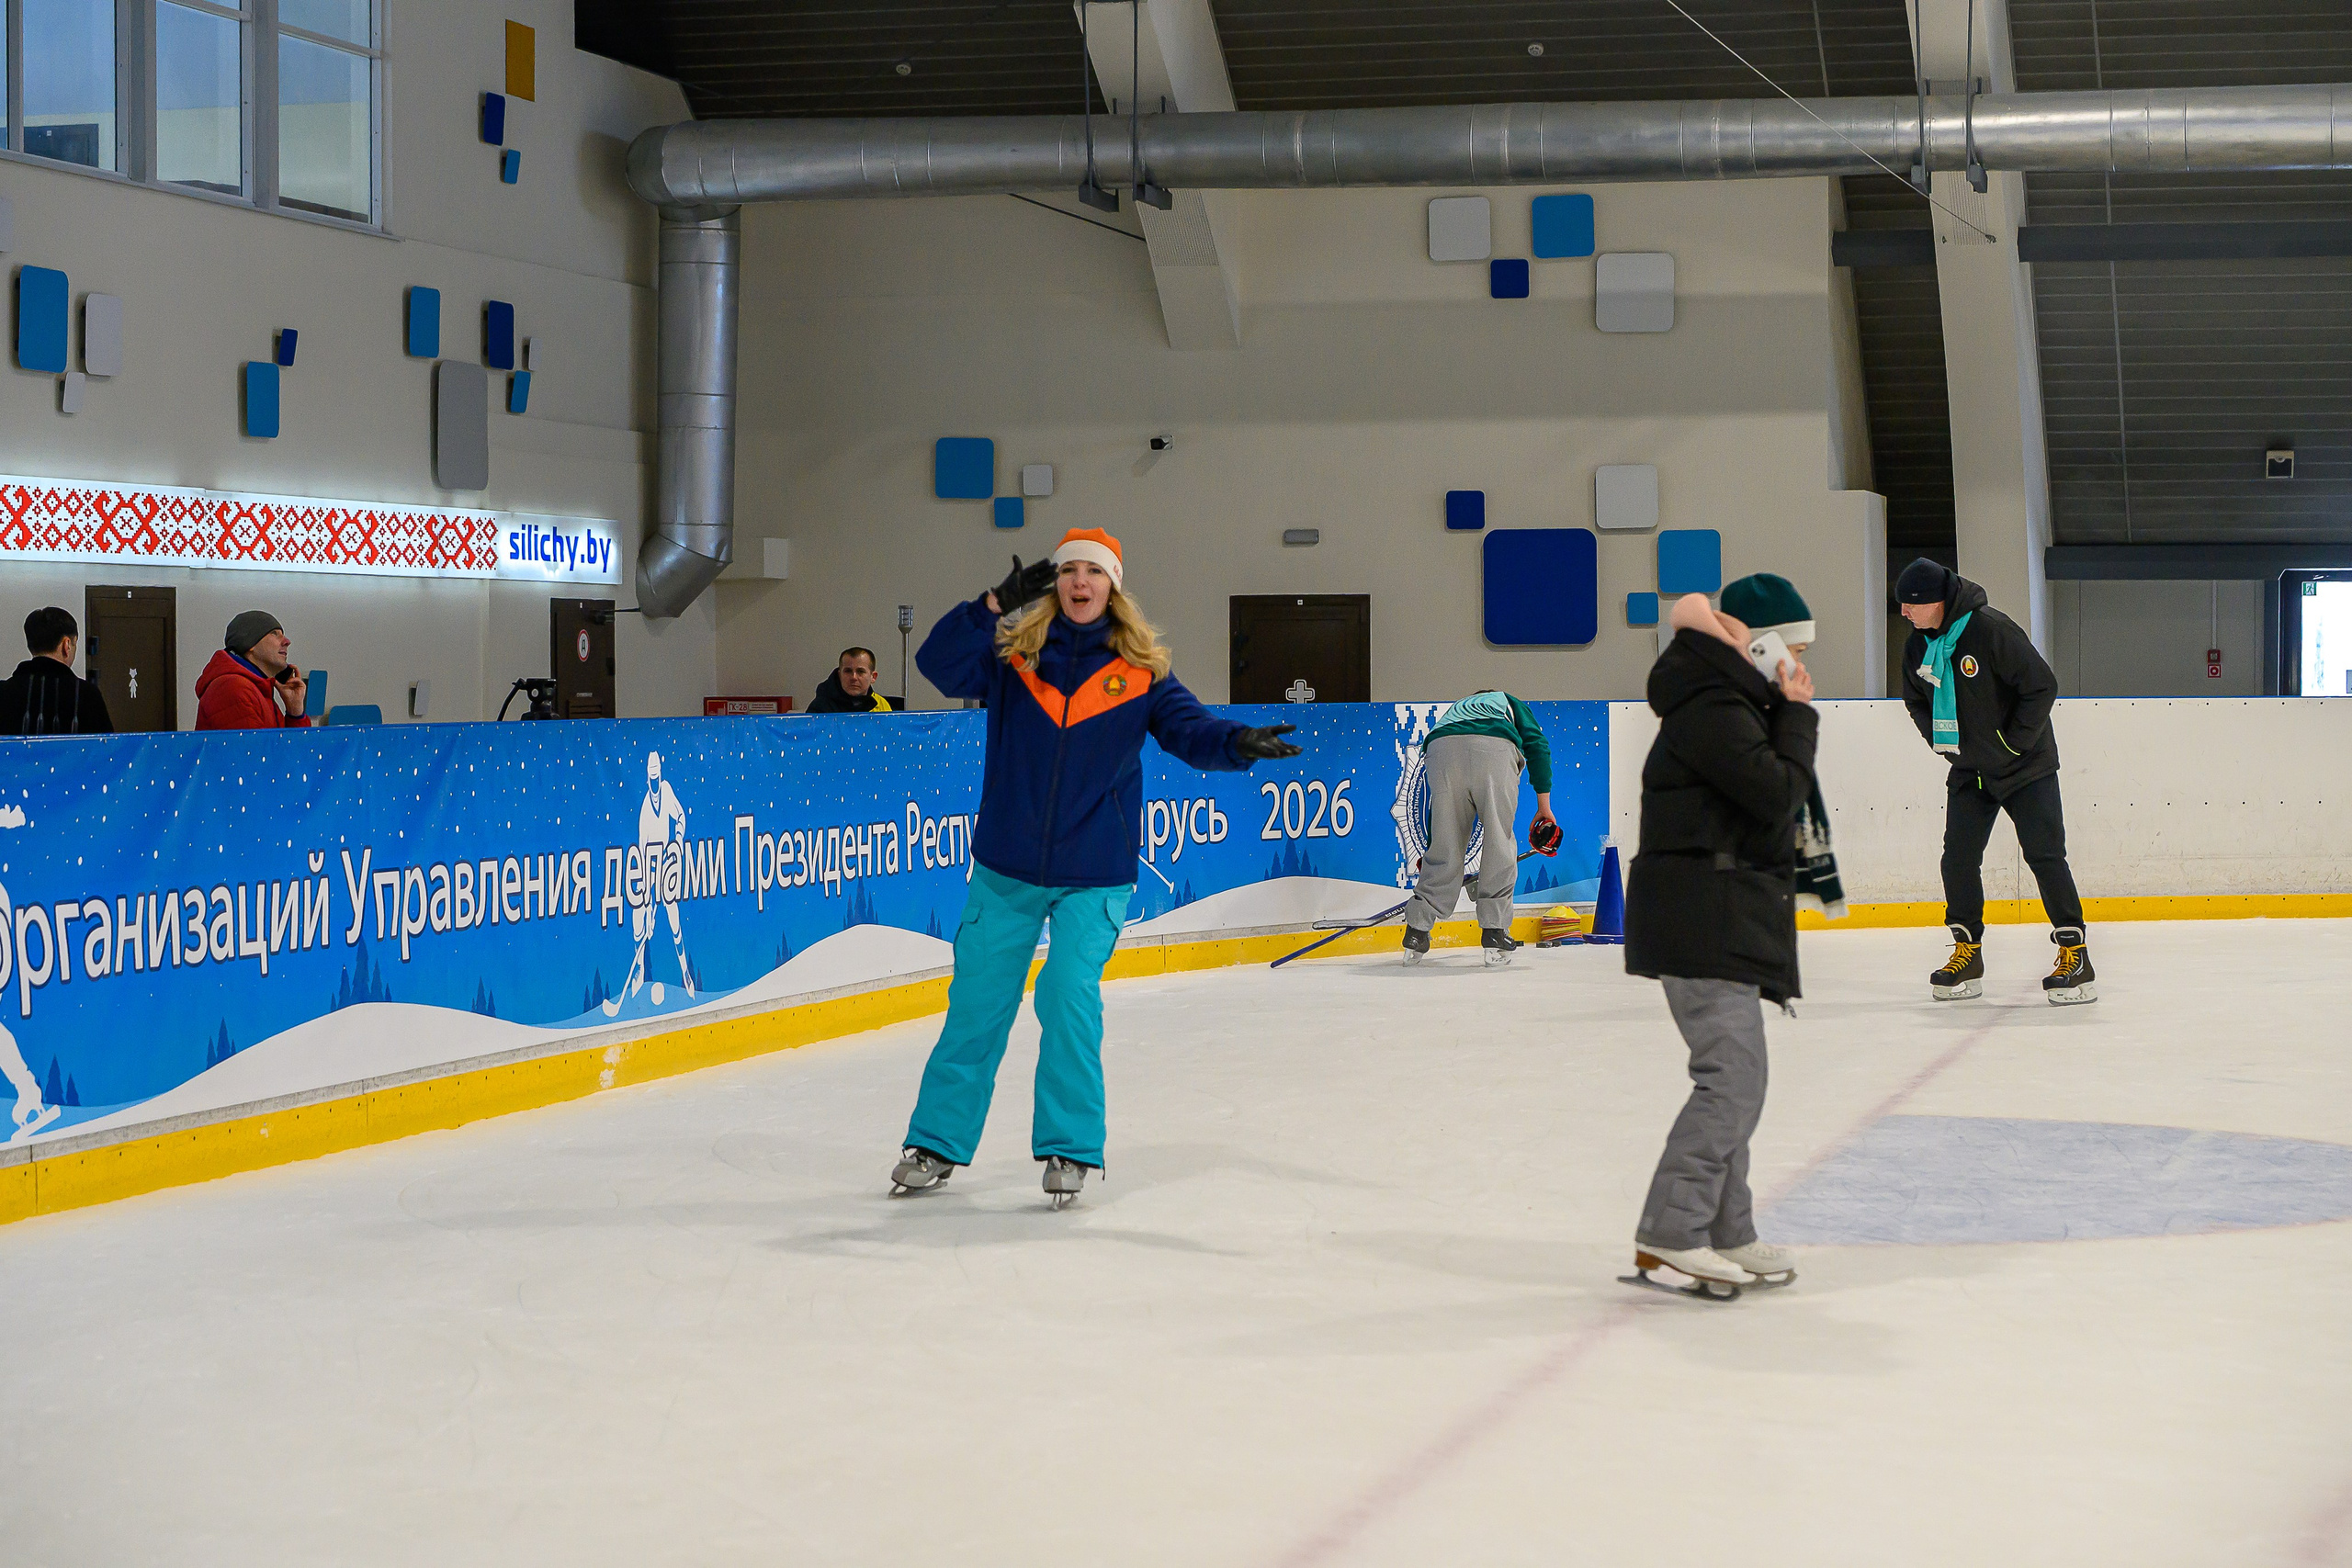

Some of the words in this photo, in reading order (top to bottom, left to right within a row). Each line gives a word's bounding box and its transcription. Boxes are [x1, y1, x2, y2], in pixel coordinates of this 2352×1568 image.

[510, 524, 612, 573] silichy.by
[0, 850, 331, 1018] рганизаций
[340, 847, 593, 962] Управления
[601, 837, 727, 929] делами
[735, 814, 899, 912] Президента
[905, 800, 979, 885] Респу
[1140, 796, 1229, 864] русь
[1260, 778, 1355, 840] 2026
